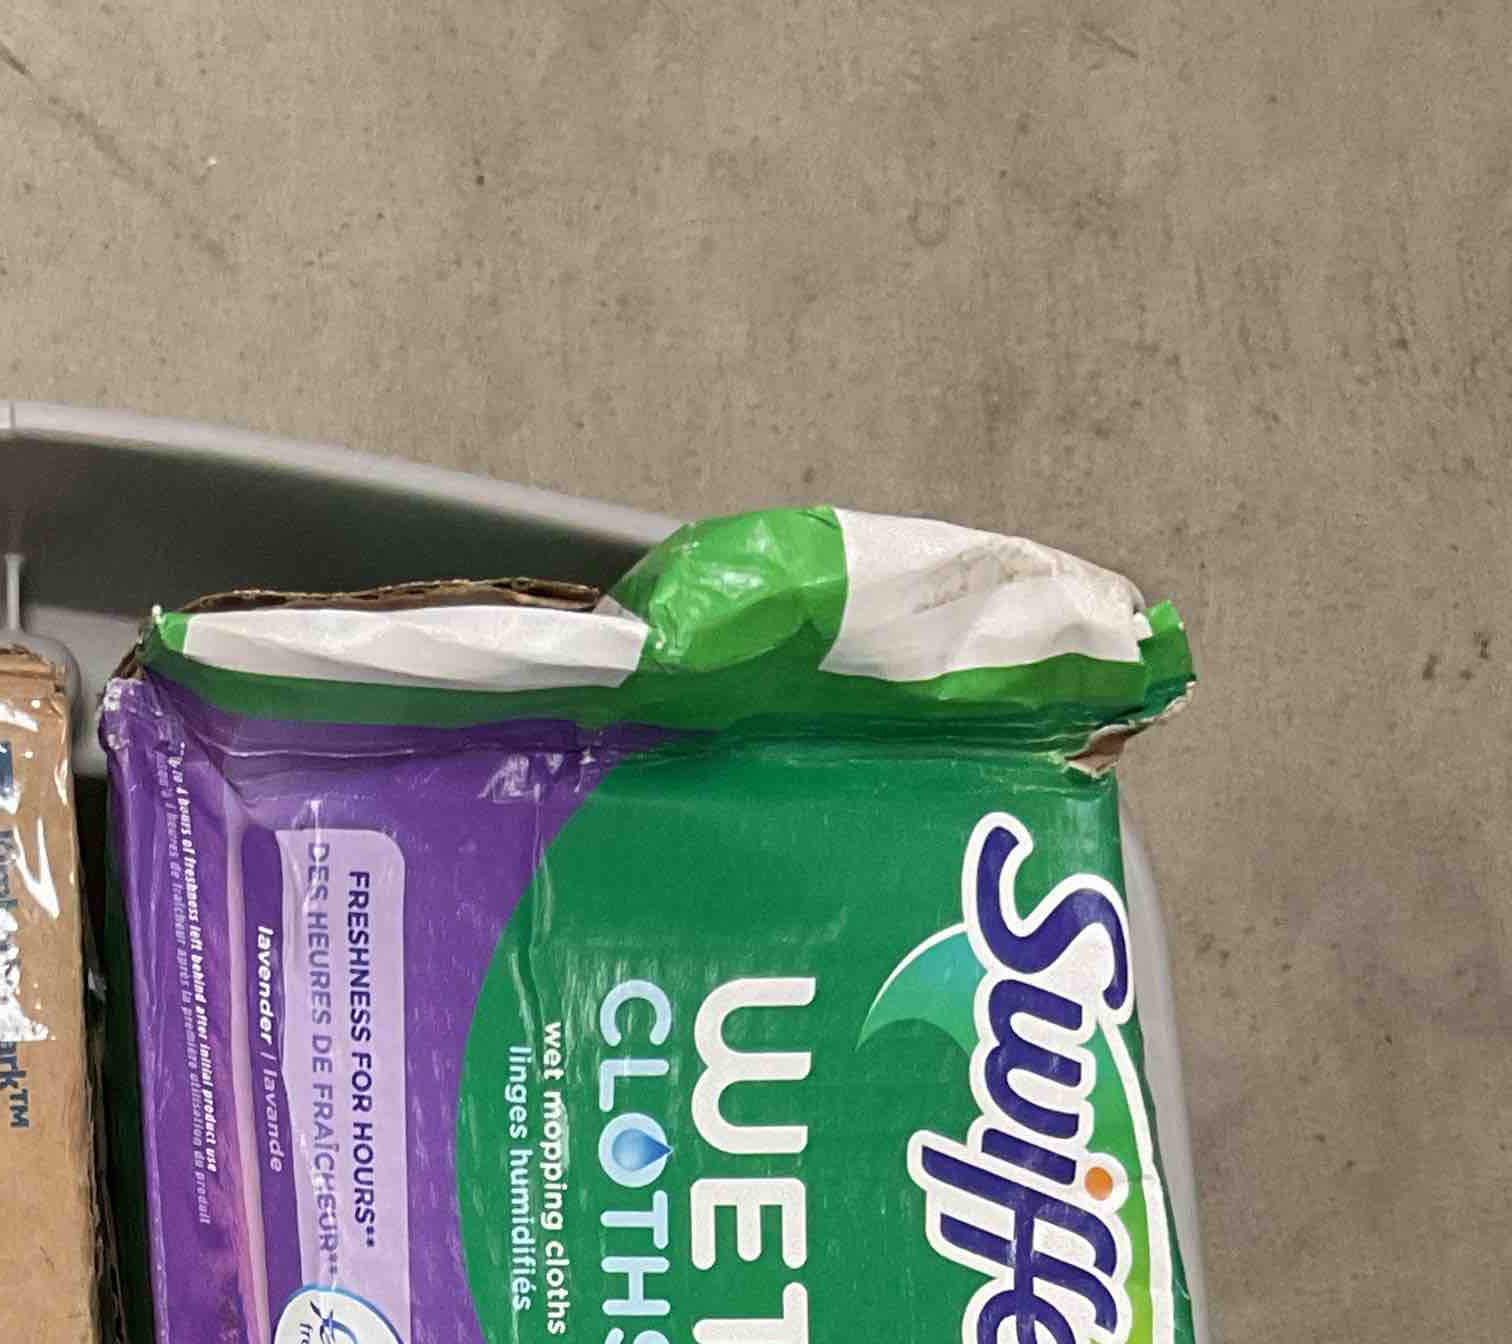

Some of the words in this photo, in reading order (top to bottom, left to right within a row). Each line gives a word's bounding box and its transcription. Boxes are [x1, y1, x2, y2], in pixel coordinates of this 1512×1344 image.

[178, 798, 191, 835] hours
[182, 839, 195, 853] of
[184, 857, 200, 921] freshness
[307, 842, 330, 909] DES
[189, 926, 202, 950] left
[347, 871, 371, 1041] FRESHNESS
[192, 954, 207, 1002] behind
[256, 926, 275, 1044] lavender
[307, 912, 332, 1025] HEURES
[195, 1006, 208, 1039] after
[543, 1022, 565, 1080] wet
[200, 1045, 213, 1085] initial
[312, 1034, 333, 1072] DE
[351, 1052, 372, 1111] FOR
[202, 1090, 216, 1143] product
[262, 1068, 285, 1171] lavande
[505, 1047, 532, 1138] linges
[207, 1149, 217, 1172] use
[539, 1090, 568, 1230] mopping
[510, 1149, 537, 1310] humidifiés
[546, 1241, 570, 1334] cloths
